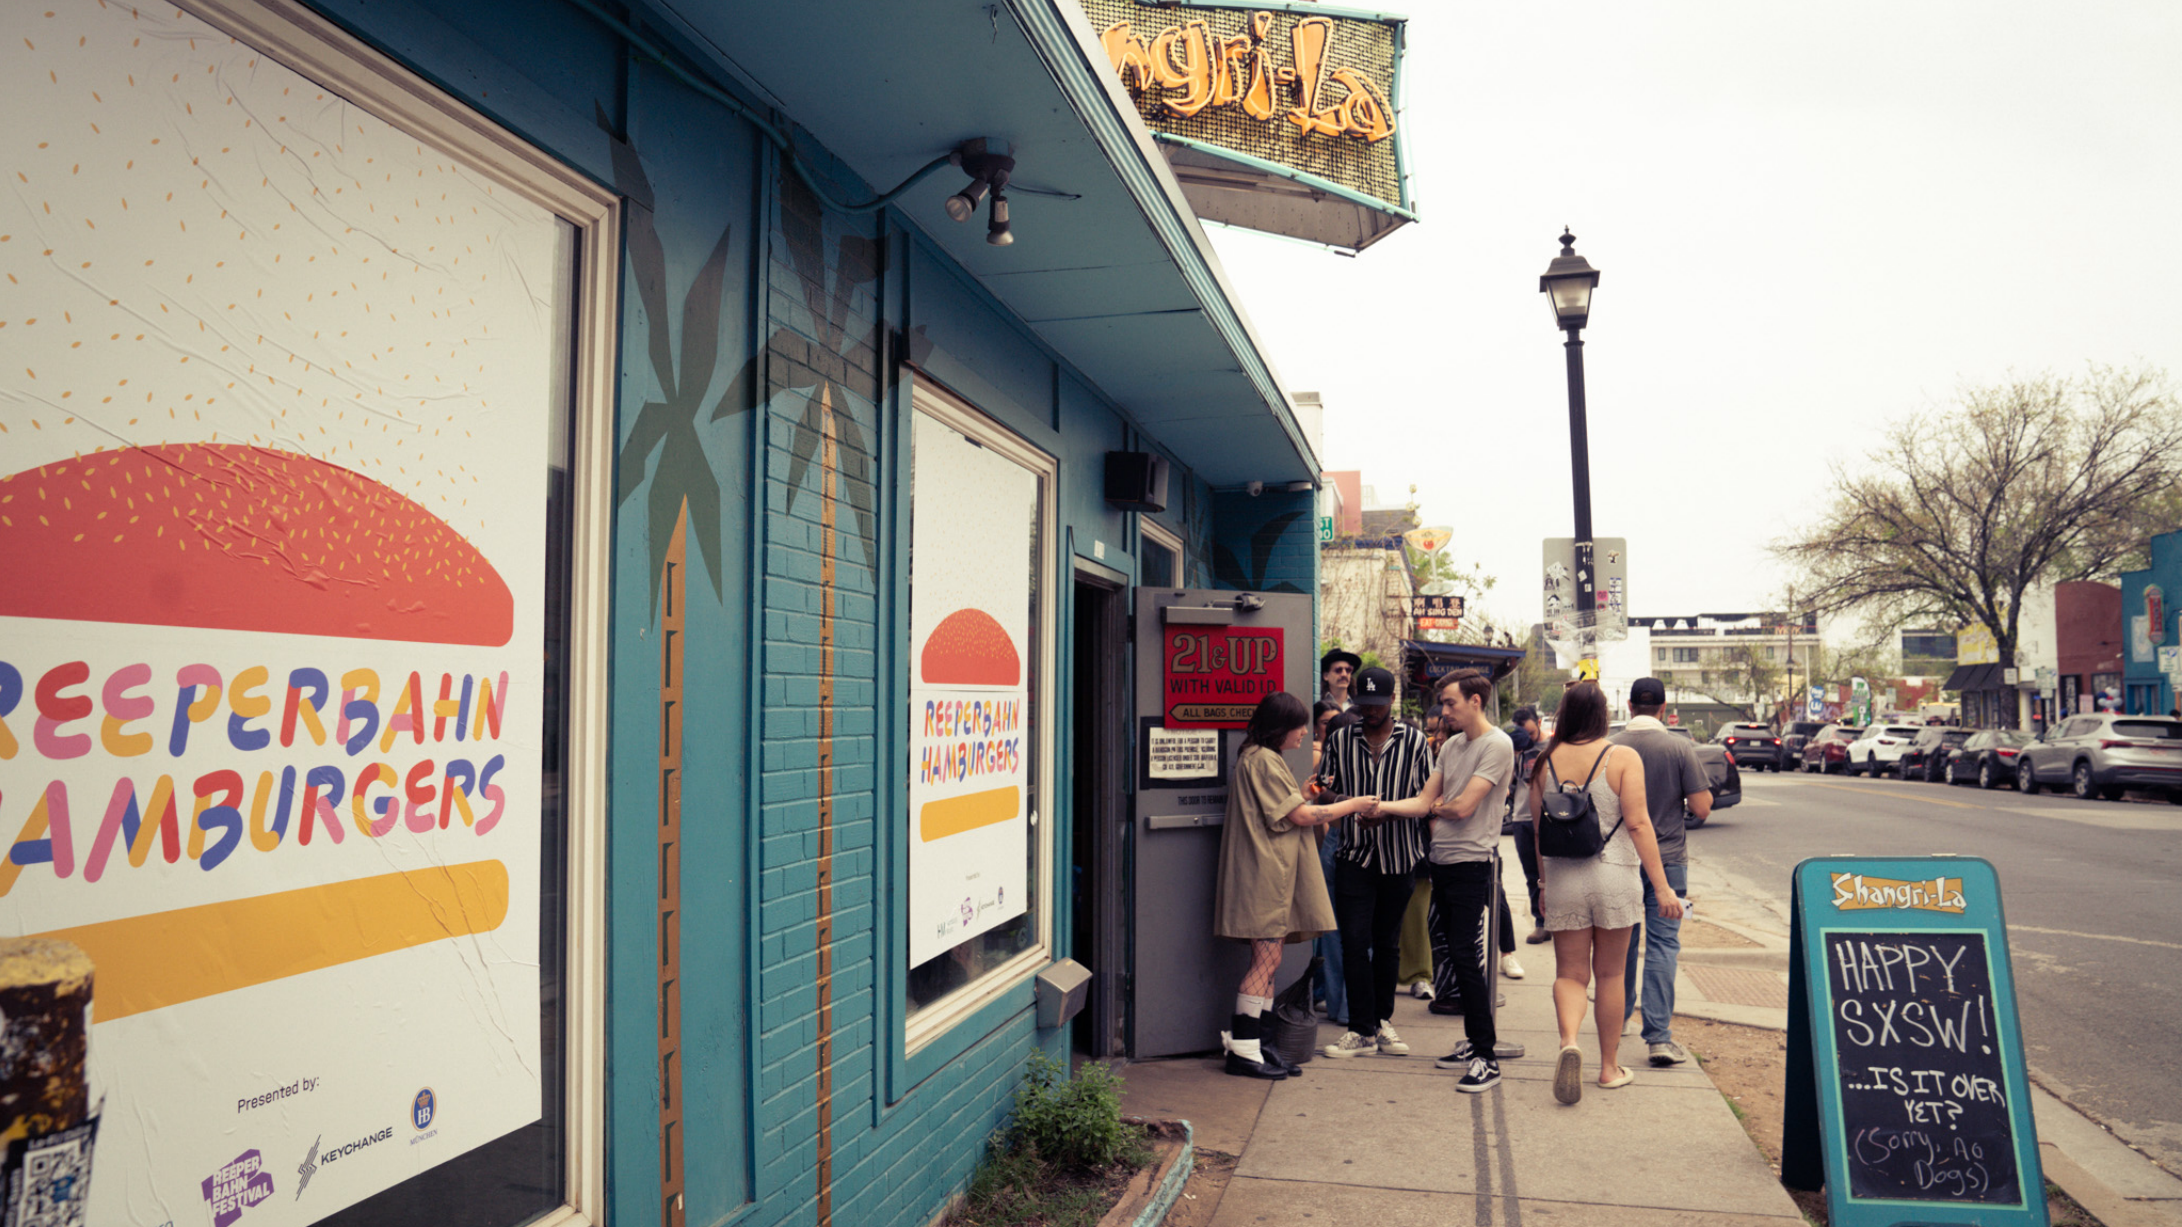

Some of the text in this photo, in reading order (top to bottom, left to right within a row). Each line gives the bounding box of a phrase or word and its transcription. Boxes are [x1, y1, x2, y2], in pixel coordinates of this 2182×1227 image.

[1170, 679, 1209, 694] WITH
[1214, 679, 1256, 694] VALID
[924, 698, 1020, 737] REEPERBAHN
[1182, 708, 1200, 717] ALL
[1204, 708, 1226, 718] BAGS
[921, 737, 1019, 786] HAMBURGERS
[0, 755, 506, 899] AMBURGERS
[1831, 871, 1968, 911] Shangri-La
[1835, 940, 1967, 993] HAPPY
[1841, 995, 1991, 1055] SXSW!
[237, 1076, 320, 1114] Presented by:
[1911, 1070, 1946, 1096] IT
[1951, 1073, 2006, 1108] OVER
[418, 1106, 432, 1126] HB
[1904, 1099, 1964, 1131] YET?
[321, 1127, 393, 1166] KEYCHANGE
[410, 1129, 438, 1146] MÜNCHEN
[1855, 1126, 1941, 1166] (Sorry,
[212, 1155, 261, 1187] REEPER
[212, 1176, 249, 1203] BAHN
[1914, 1159, 1989, 1196] Dogs)
[212, 1181, 270, 1218] FESTIVAL
